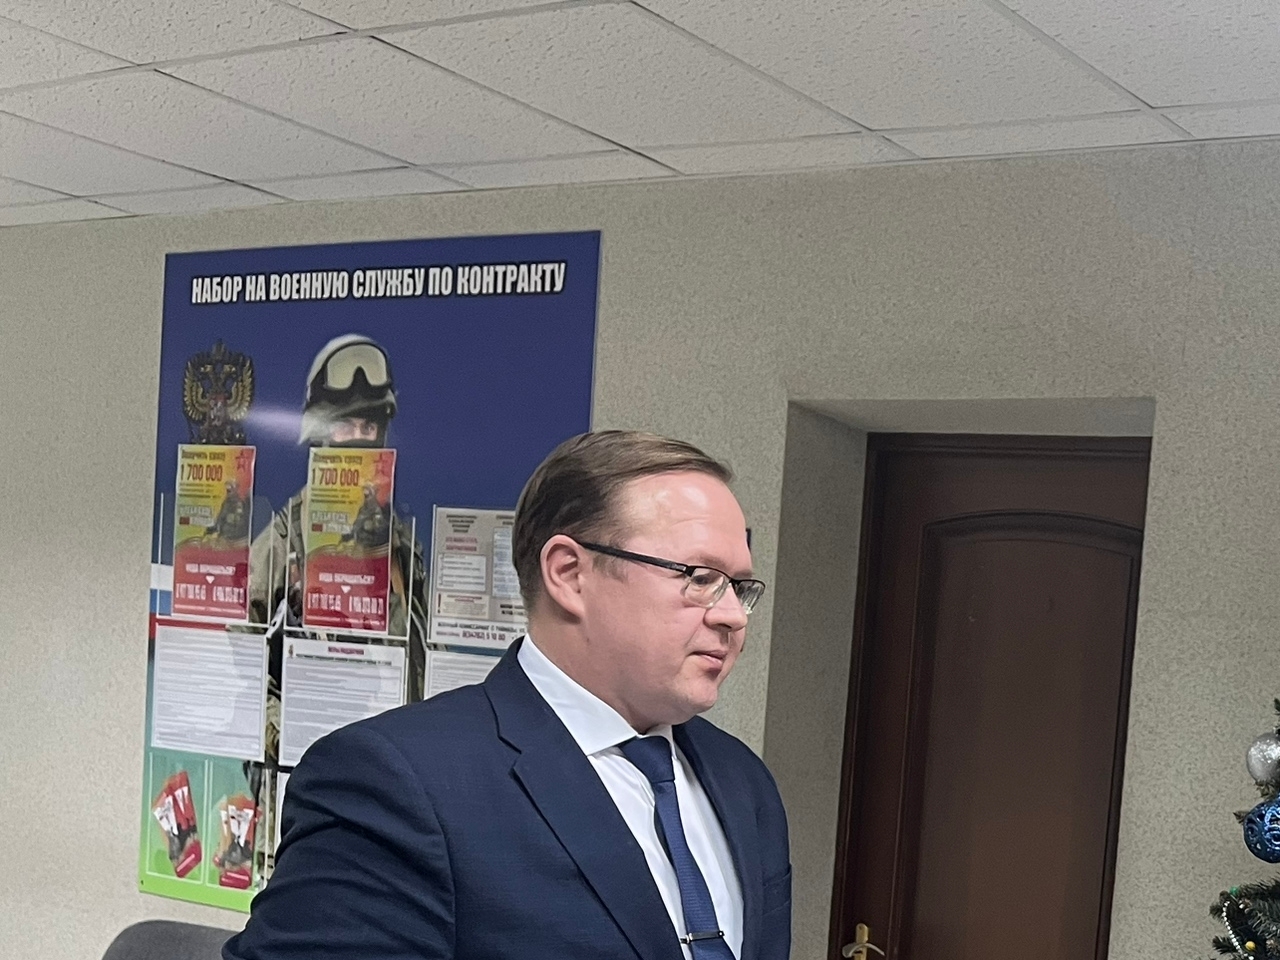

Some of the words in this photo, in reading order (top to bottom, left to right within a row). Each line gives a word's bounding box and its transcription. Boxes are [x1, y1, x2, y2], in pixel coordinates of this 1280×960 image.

[191, 276, 242, 304] НАБОР
[245, 275, 266, 301] НА
[269, 271, 349, 301] ВОЕННУЮ
[352, 268, 425, 298] СЛУЖБУ
[428, 266, 453, 296] ПО
[456, 262, 566, 295] КОНТРАКТУ
[319, 467, 338, 485] 700
[340, 468, 359, 486] 000
